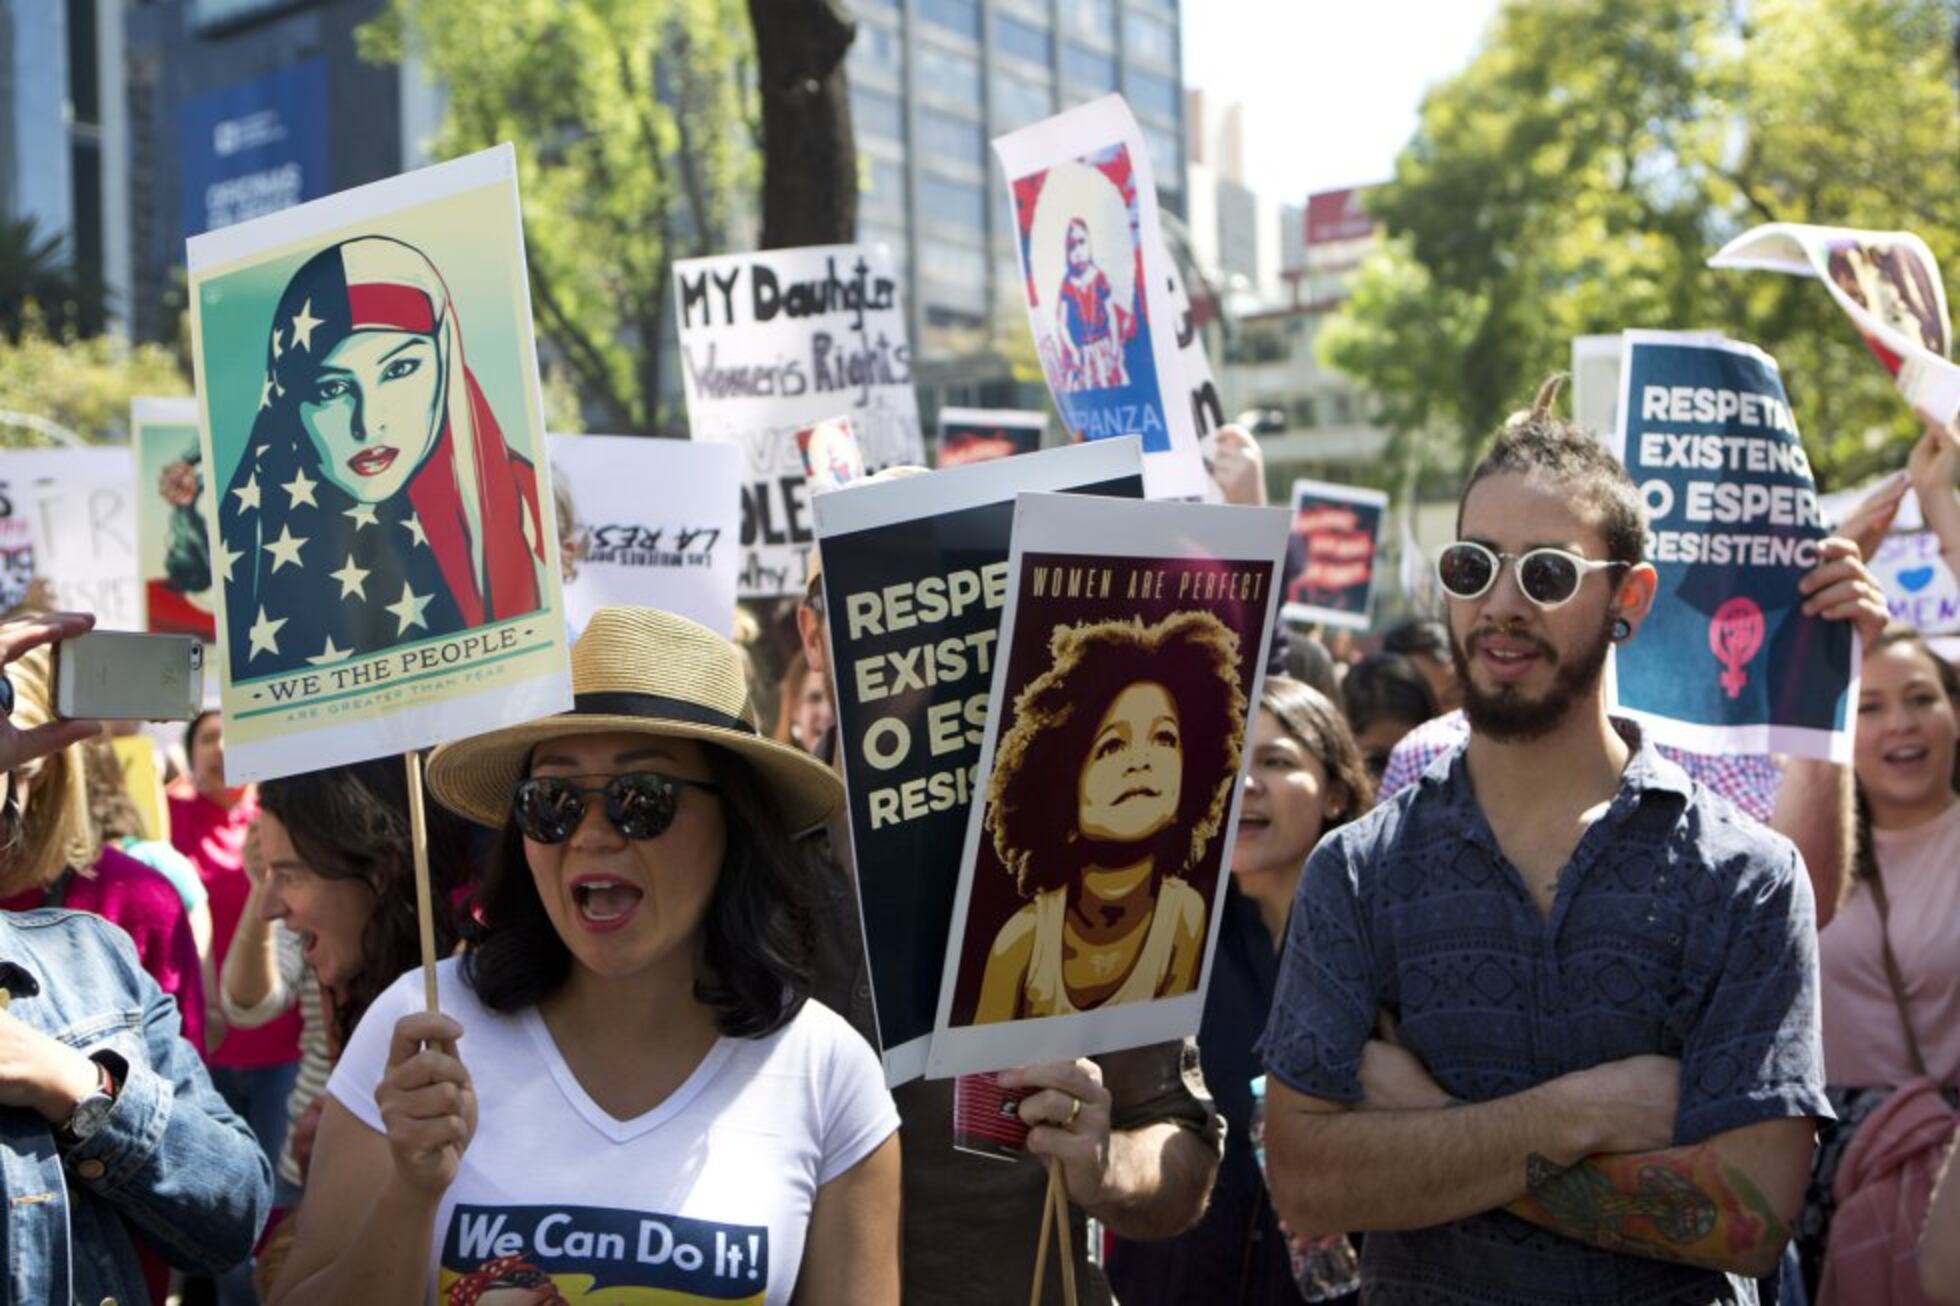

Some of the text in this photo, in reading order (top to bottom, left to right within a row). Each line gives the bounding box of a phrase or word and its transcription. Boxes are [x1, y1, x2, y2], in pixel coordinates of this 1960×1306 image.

[680, 266, 740, 329] MY
[1640, 479, 1675, 521] O
[846, 561, 1009, 640] RESPE
[1033, 566, 1264, 600] WOMEN ARE PERFECT
[267, 626, 520, 703] WE THE PEOPLE
[287, 708, 319, 722] ARE
[328, 689, 404, 715] GREATER
[410, 676, 457, 696] THAN
[465, 665, 505, 682] FEAR
[854, 629, 998, 703] EXIST
[862, 692, 991, 770] O ES
[458, 1212, 760, 1280] We Can Do It!
